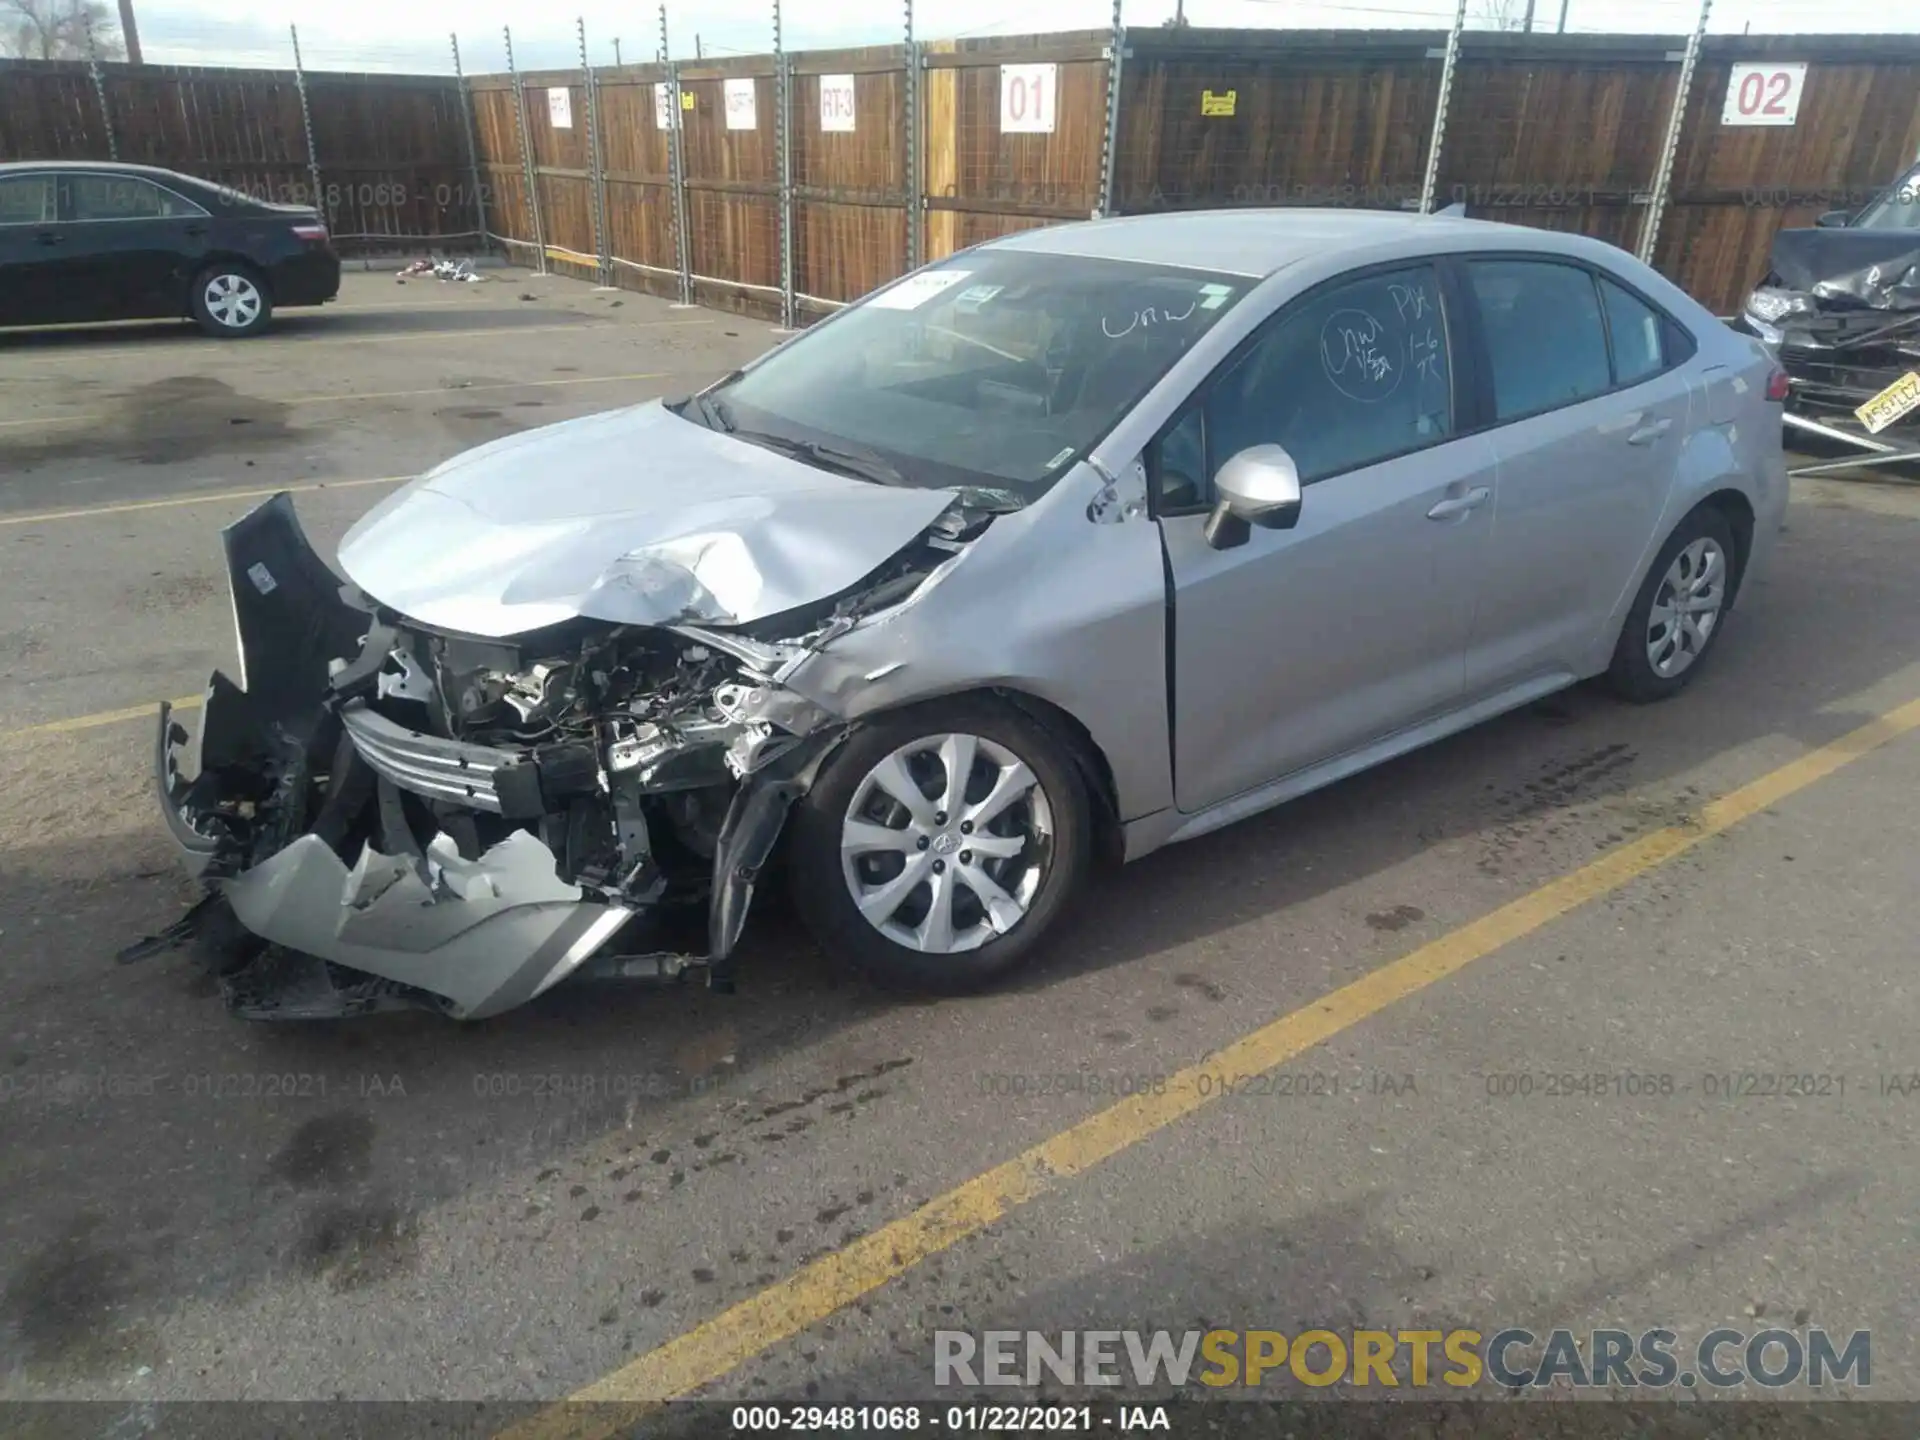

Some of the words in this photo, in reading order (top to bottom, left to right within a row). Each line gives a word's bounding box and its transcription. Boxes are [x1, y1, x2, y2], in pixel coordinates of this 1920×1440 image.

[823, 88, 853, 118] RT-3
[1009, 75, 1042, 121] 01
[1738, 72, 1791, 116] 02
